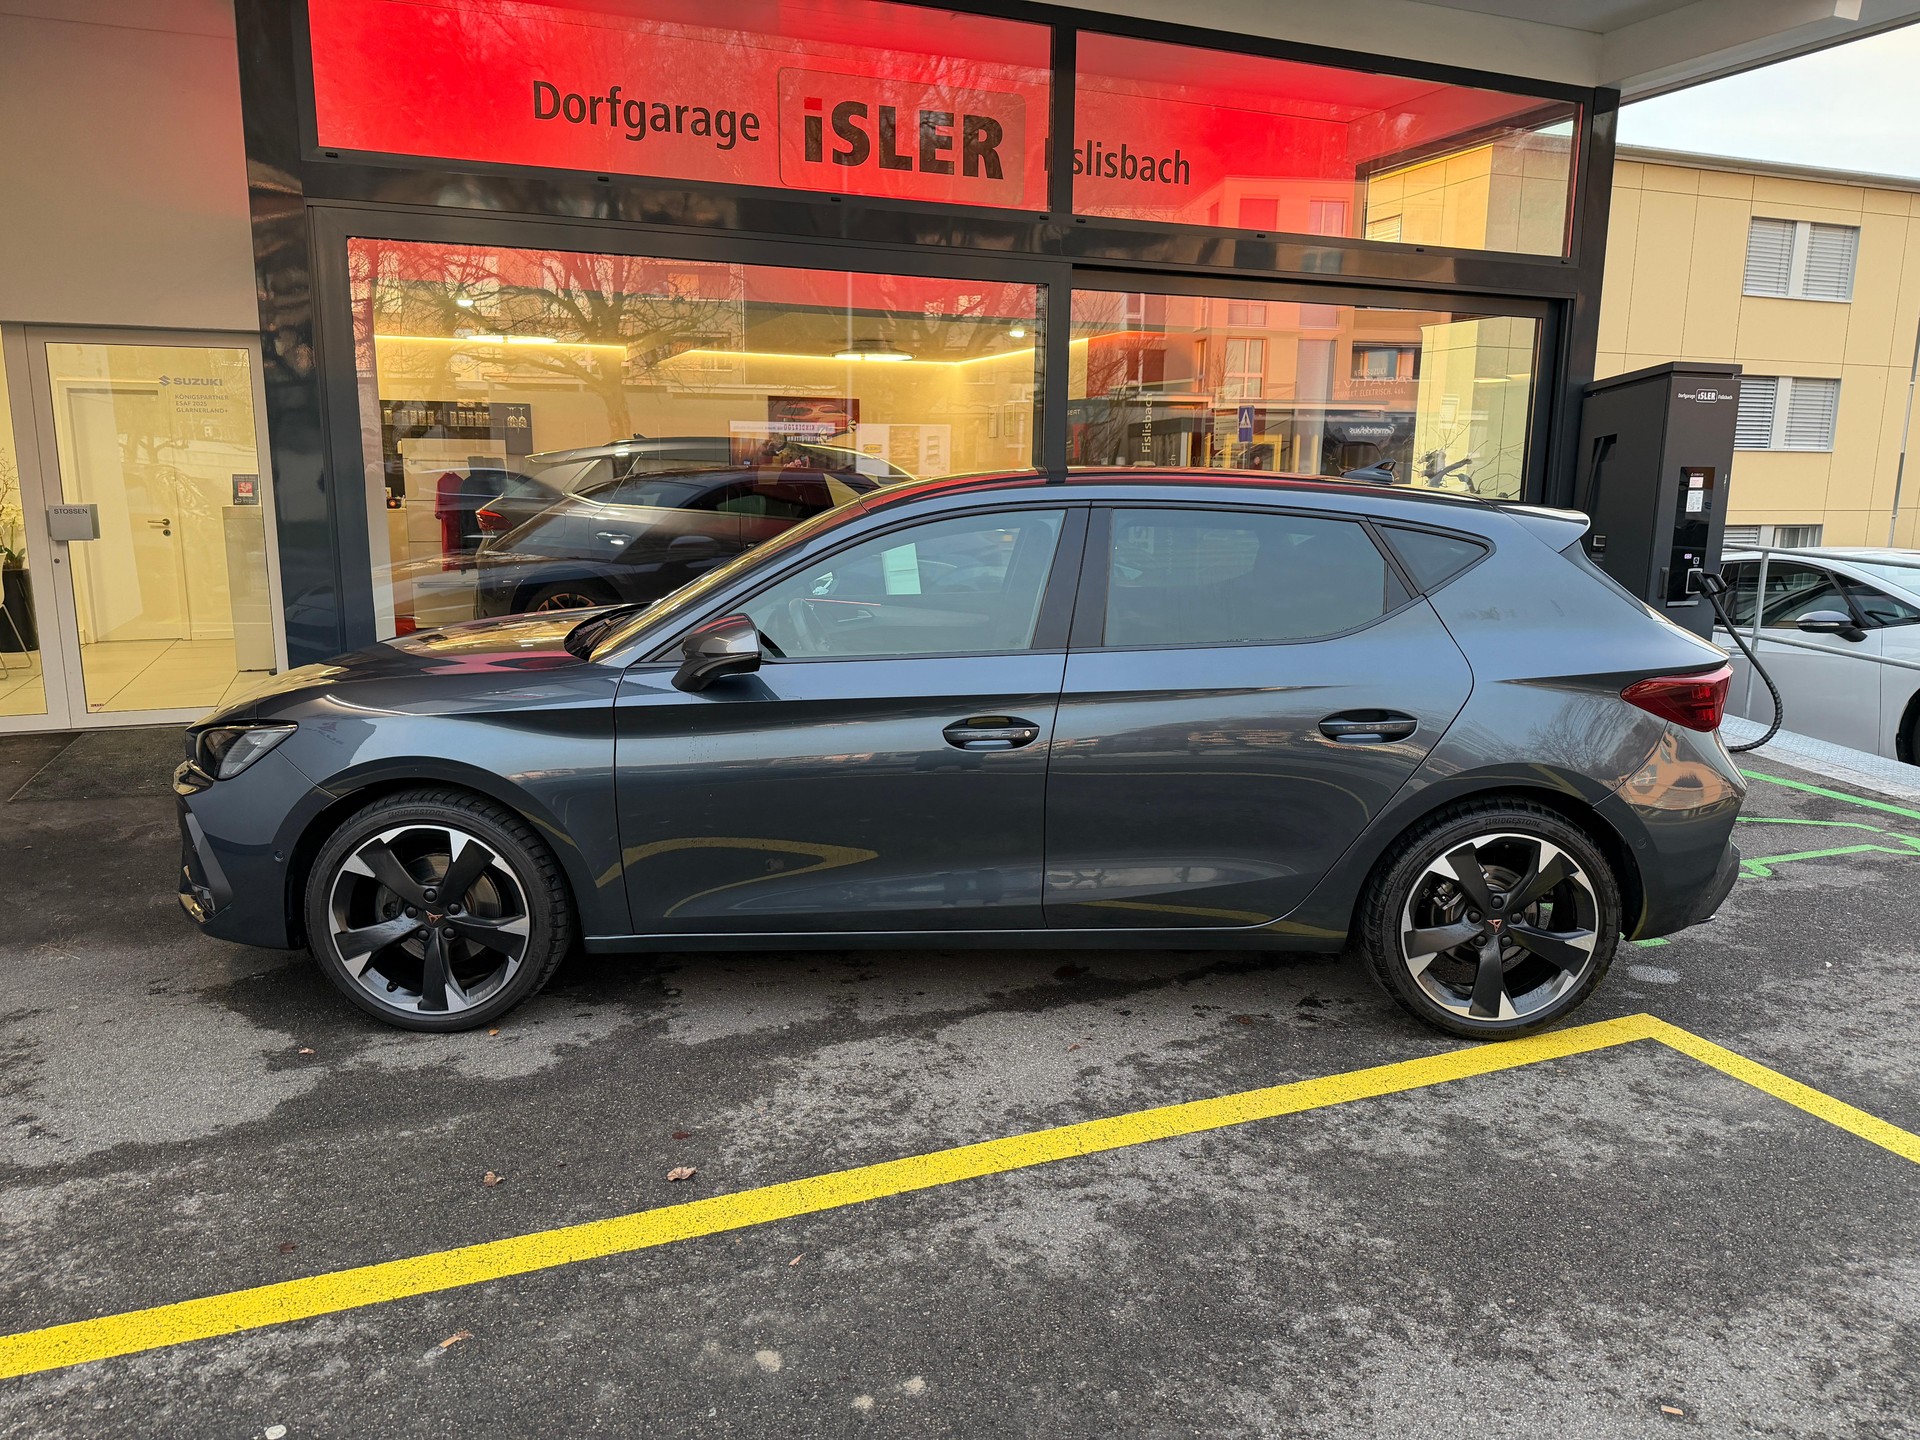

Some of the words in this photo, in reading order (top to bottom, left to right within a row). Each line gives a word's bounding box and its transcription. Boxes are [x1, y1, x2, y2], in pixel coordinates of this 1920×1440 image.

[533, 80, 760, 150] Dorfgarage
[804, 96, 1004, 180] iSLER
[1045, 138, 1190, 185] slisbach
[174, 378, 222, 386] SUZUKI
[1344, 376, 1408, 388] VITARA
[1142, 393, 1153, 453] Fislisbach
[388, 809, 446, 818] BRIDGESTONE
[1484, 817, 1542, 828] BRIDGESTONE
